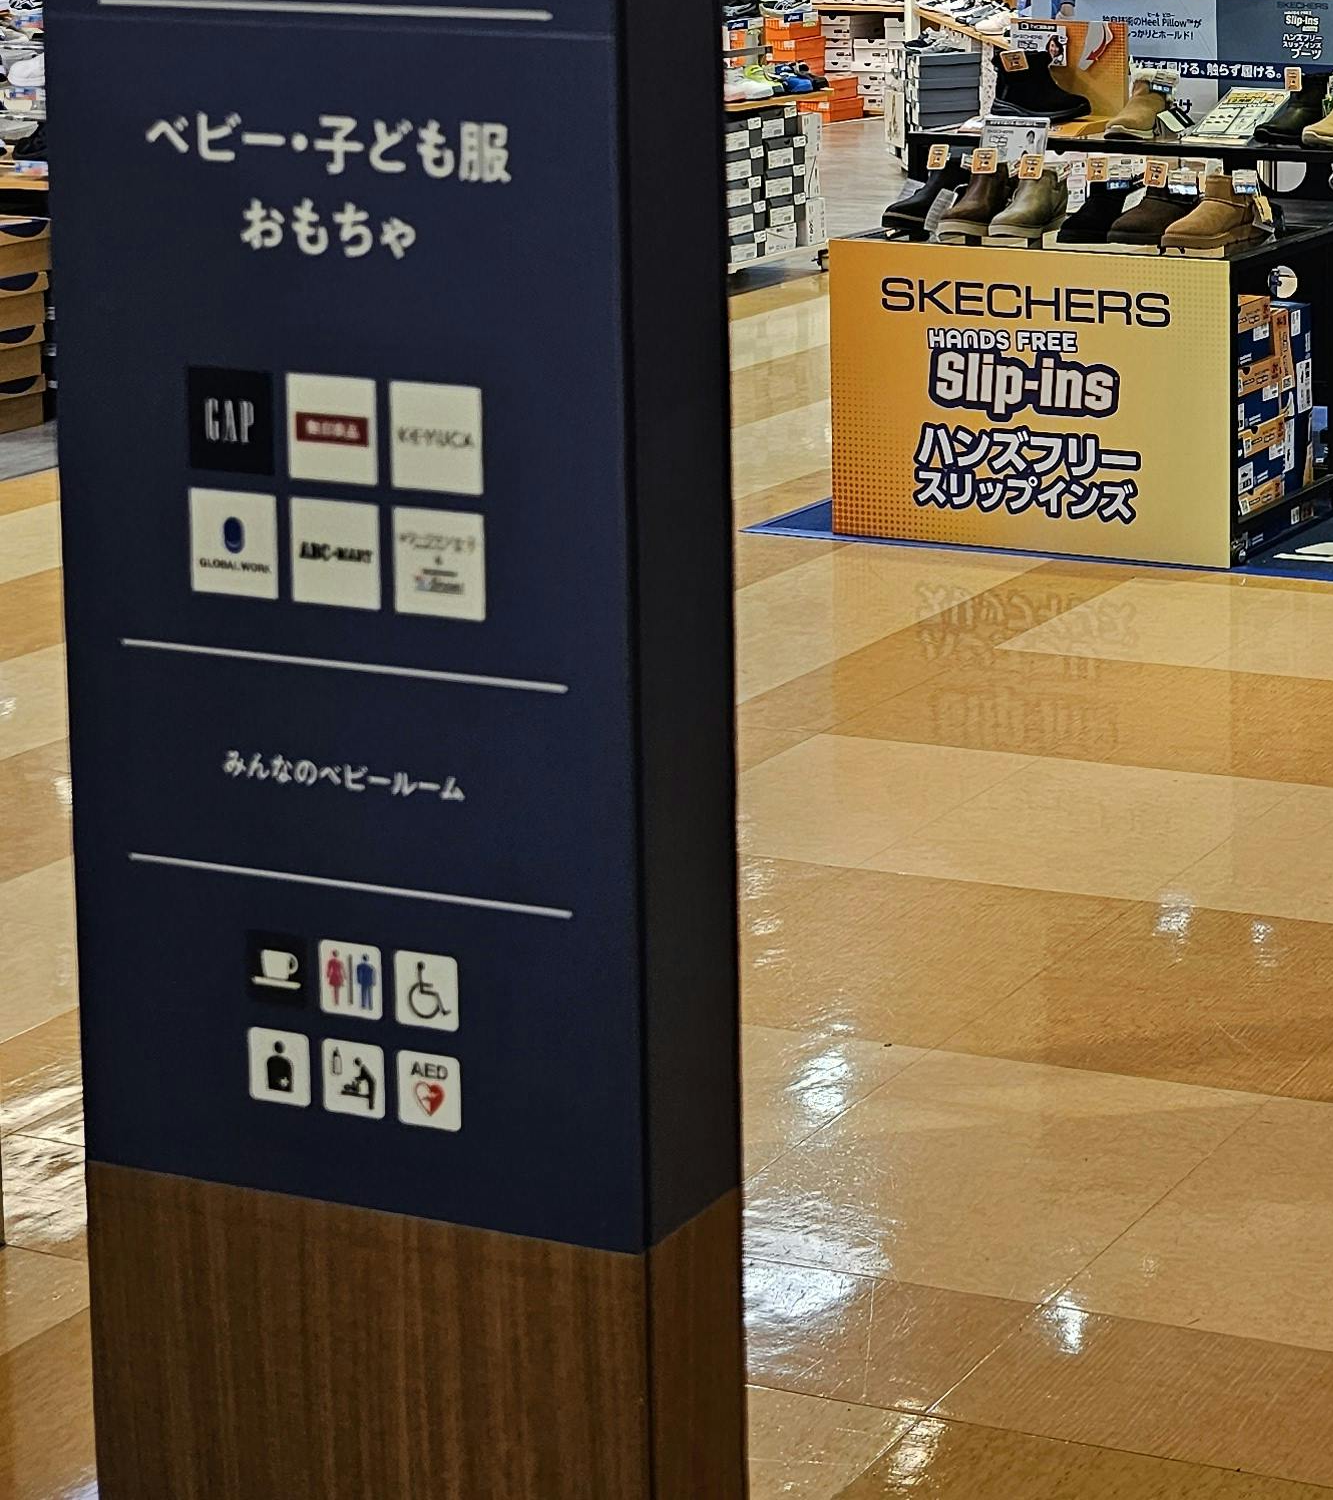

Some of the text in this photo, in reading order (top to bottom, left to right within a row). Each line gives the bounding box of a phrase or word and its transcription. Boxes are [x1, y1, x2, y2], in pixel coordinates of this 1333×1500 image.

[146, 109, 512, 185] ベビー・子ども服
[240, 197, 417, 260] おもちゃ
[880, 276, 1171, 328] SKECHERS
[927, 328, 1077, 354] HANDS FREE
[934, 350, 1116, 414] Slip-ins
[204, 397, 255, 443] GAP
[917, 425, 1140, 477] ハンズフリー
[916, 471, 1137, 522] スリップインズ
[199, 557, 240, 572] GLOBAL
[299, 541, 373, 564] ABC-MART
[222, 749, 466, 803] みんなのベビールーム
[410, 1060, 449, 1082] AED
